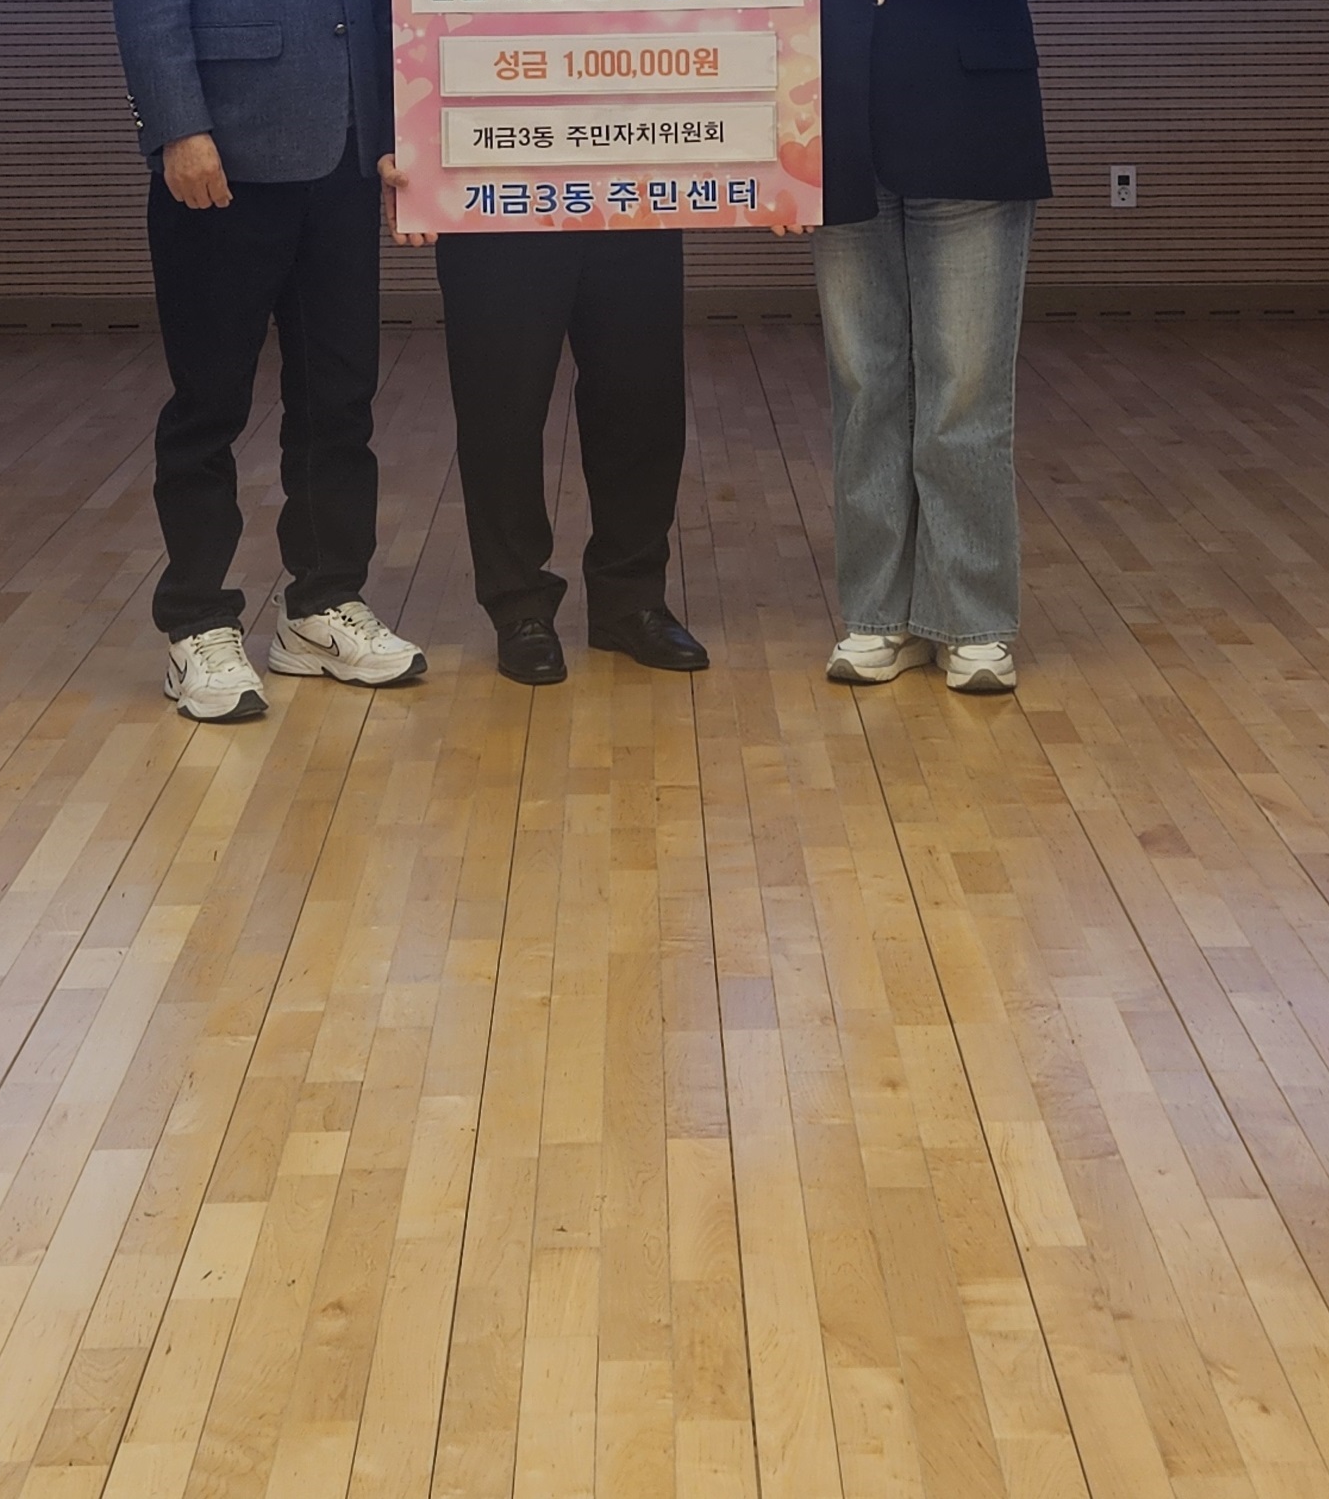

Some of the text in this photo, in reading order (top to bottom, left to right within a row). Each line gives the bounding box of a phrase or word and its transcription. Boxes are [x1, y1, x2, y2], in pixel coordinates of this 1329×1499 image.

[493, 47, 720, 80] 성금 1,000,000원
[472, 120, 725, 149] 개금3동 주민자치위원회
[464, 179, 759, 215] 개금3동 주민센터
